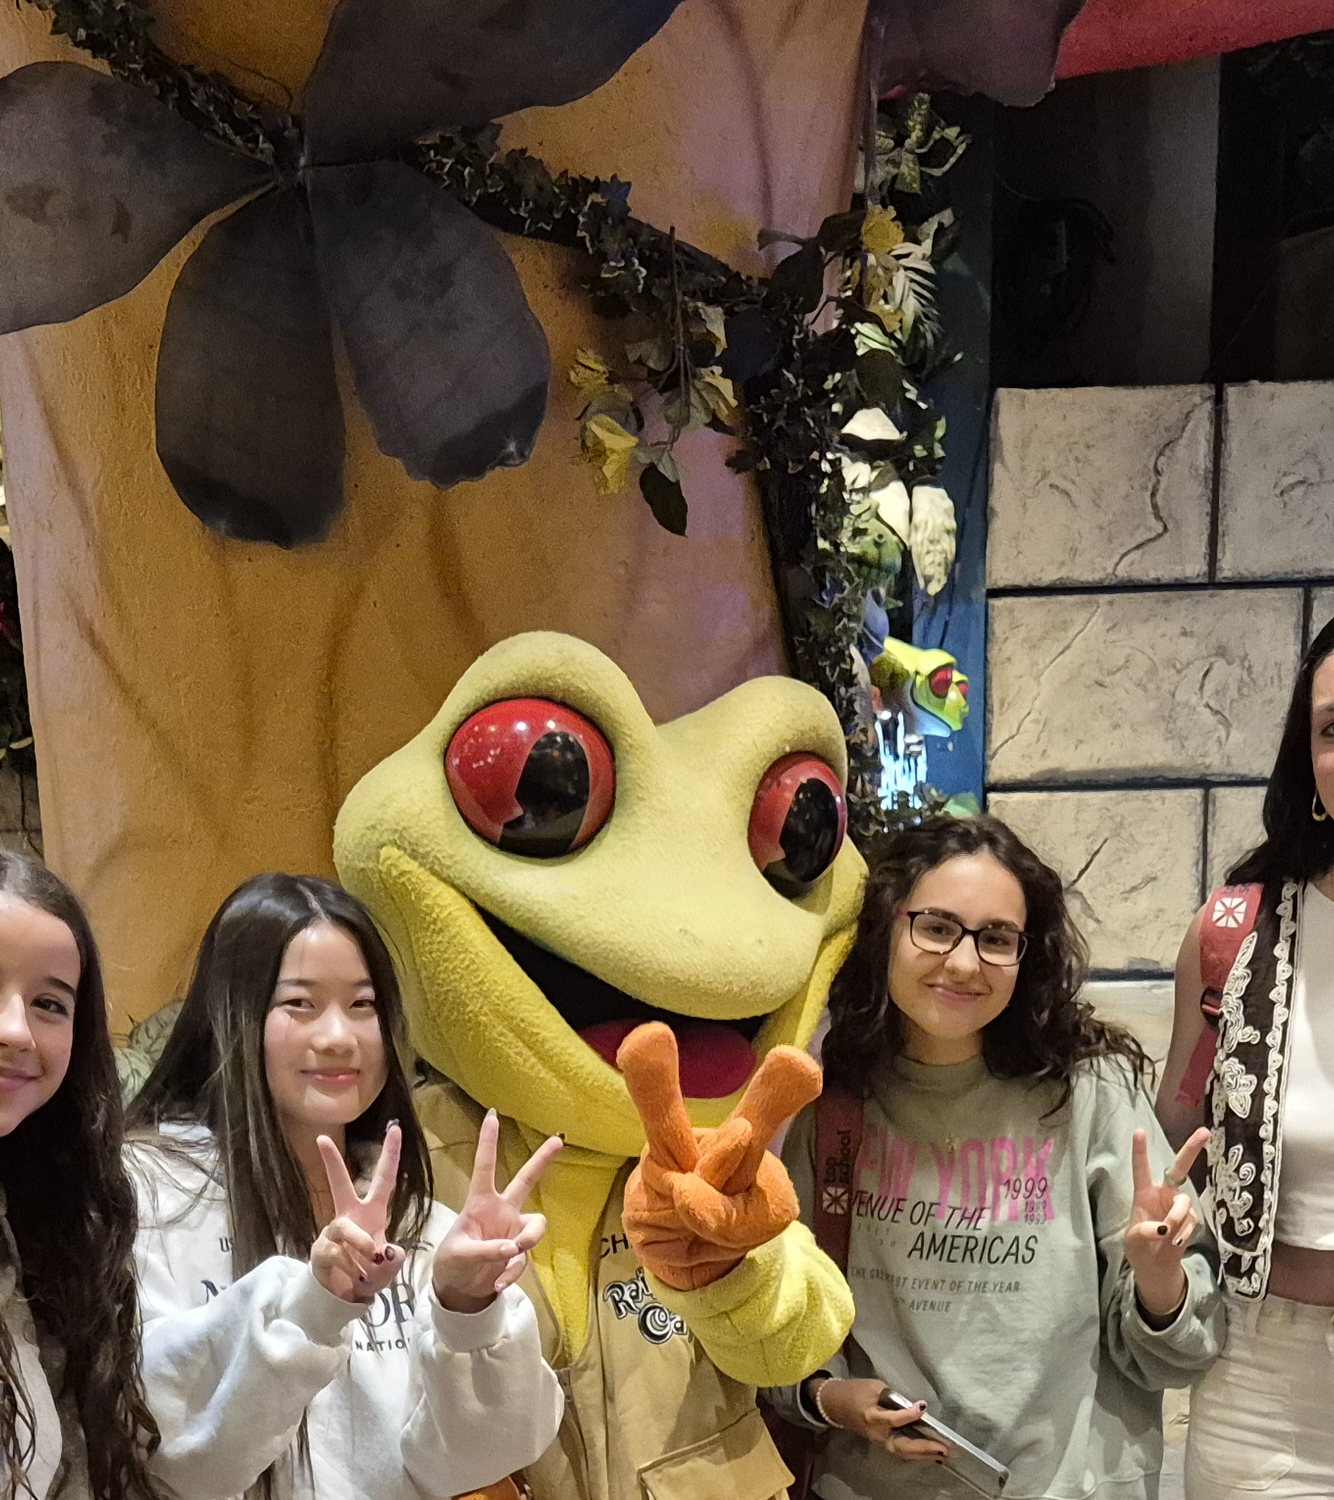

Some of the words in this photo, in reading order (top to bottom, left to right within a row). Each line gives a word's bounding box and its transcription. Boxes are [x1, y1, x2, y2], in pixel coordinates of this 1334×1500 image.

[929, 1136, 1057, 1222] YORK
[1003, 1176, 1048, 1200] 1999
[909, 1200, 941, 1227] OF
[943, 1206, 992, 1231] THE
[599, 1232, 634, 1258] CH
[906, 1230, 1039, 1265] AMERICAS
[603, 1266, 657, 1320] Rai
[911, 1277, 947, 1292] EVENT
[949, 1280, 964, 1293] OF
[967, 1280, 989, 1294] THE
[992, 1281, 1021, 1294] YEAR
[908, 1300, 953, 1313] AVENUE
[637, 1301, 695, 1345] Ca
[355, 1338, 411, 1352] NATIO
